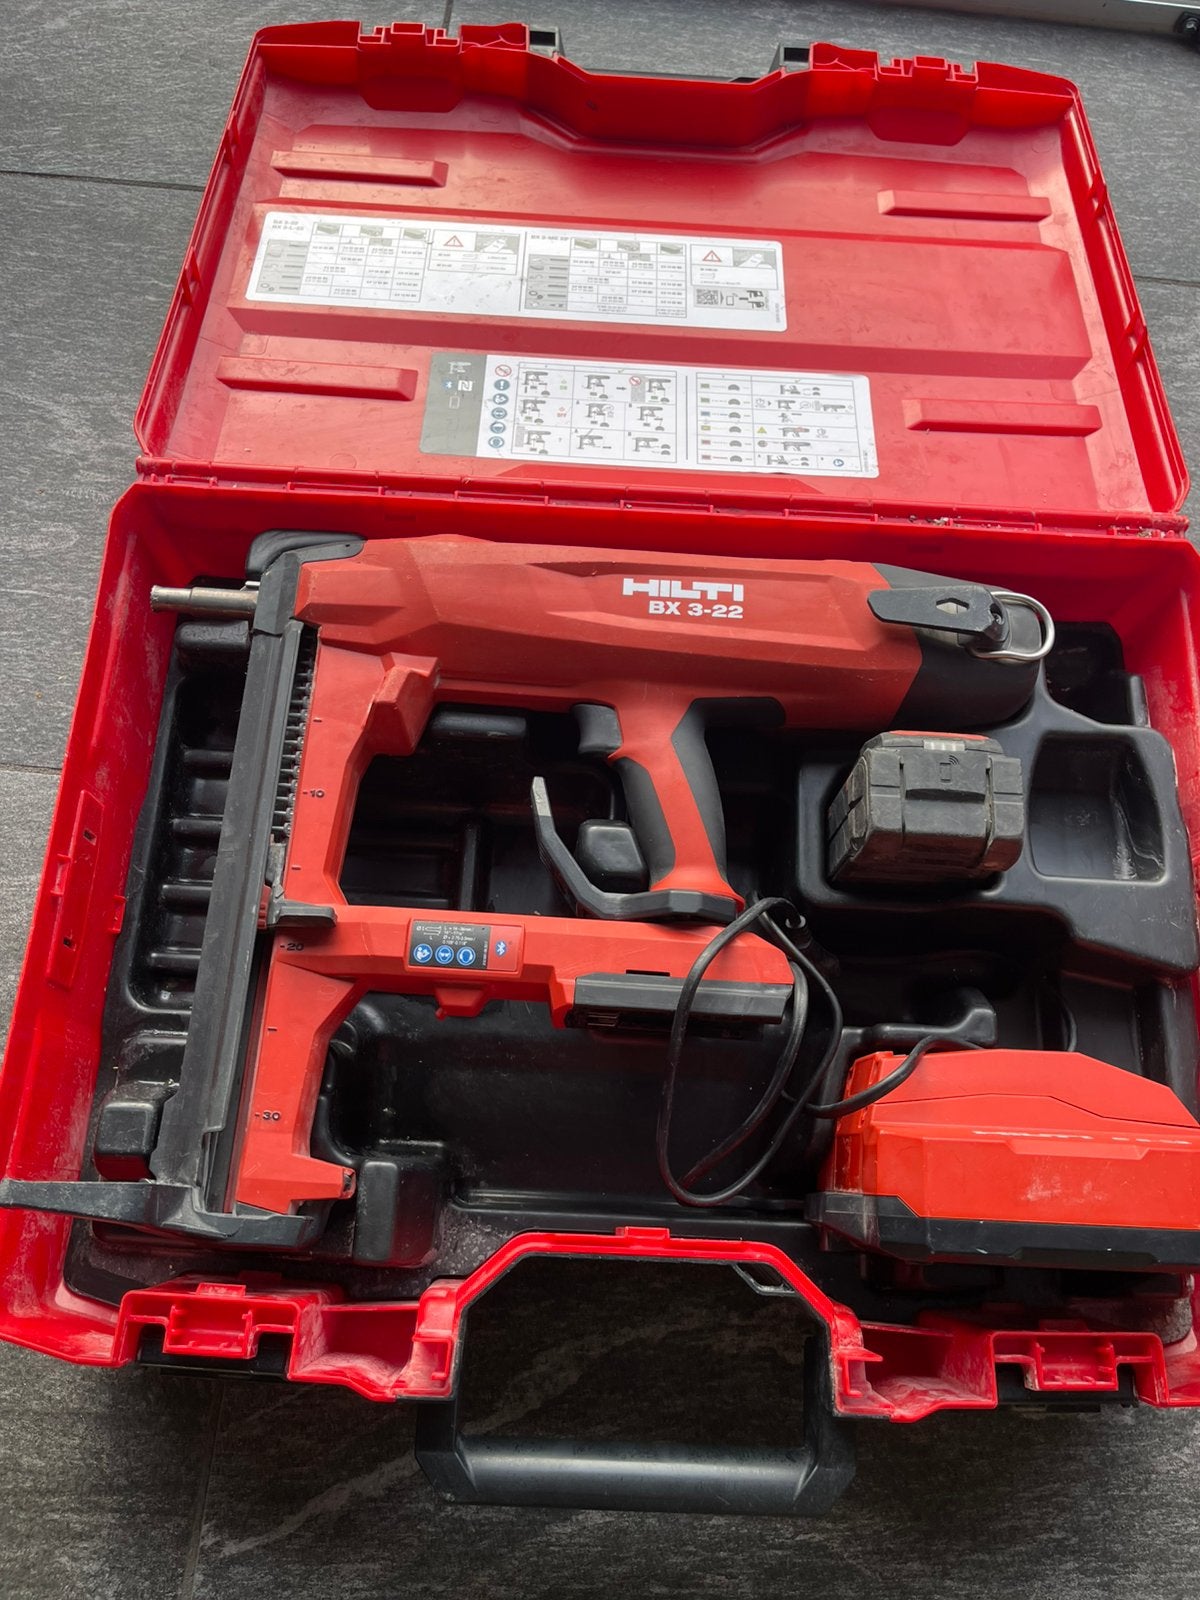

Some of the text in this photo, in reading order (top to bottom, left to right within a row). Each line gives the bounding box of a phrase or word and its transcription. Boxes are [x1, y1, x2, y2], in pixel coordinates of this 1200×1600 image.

[622, 577, 744, 602] HILTI
[648, 600, 744, 619] BX 3-22
[286, 942, 305, 951] 20
[262, 1111, 281, 1121] 30
